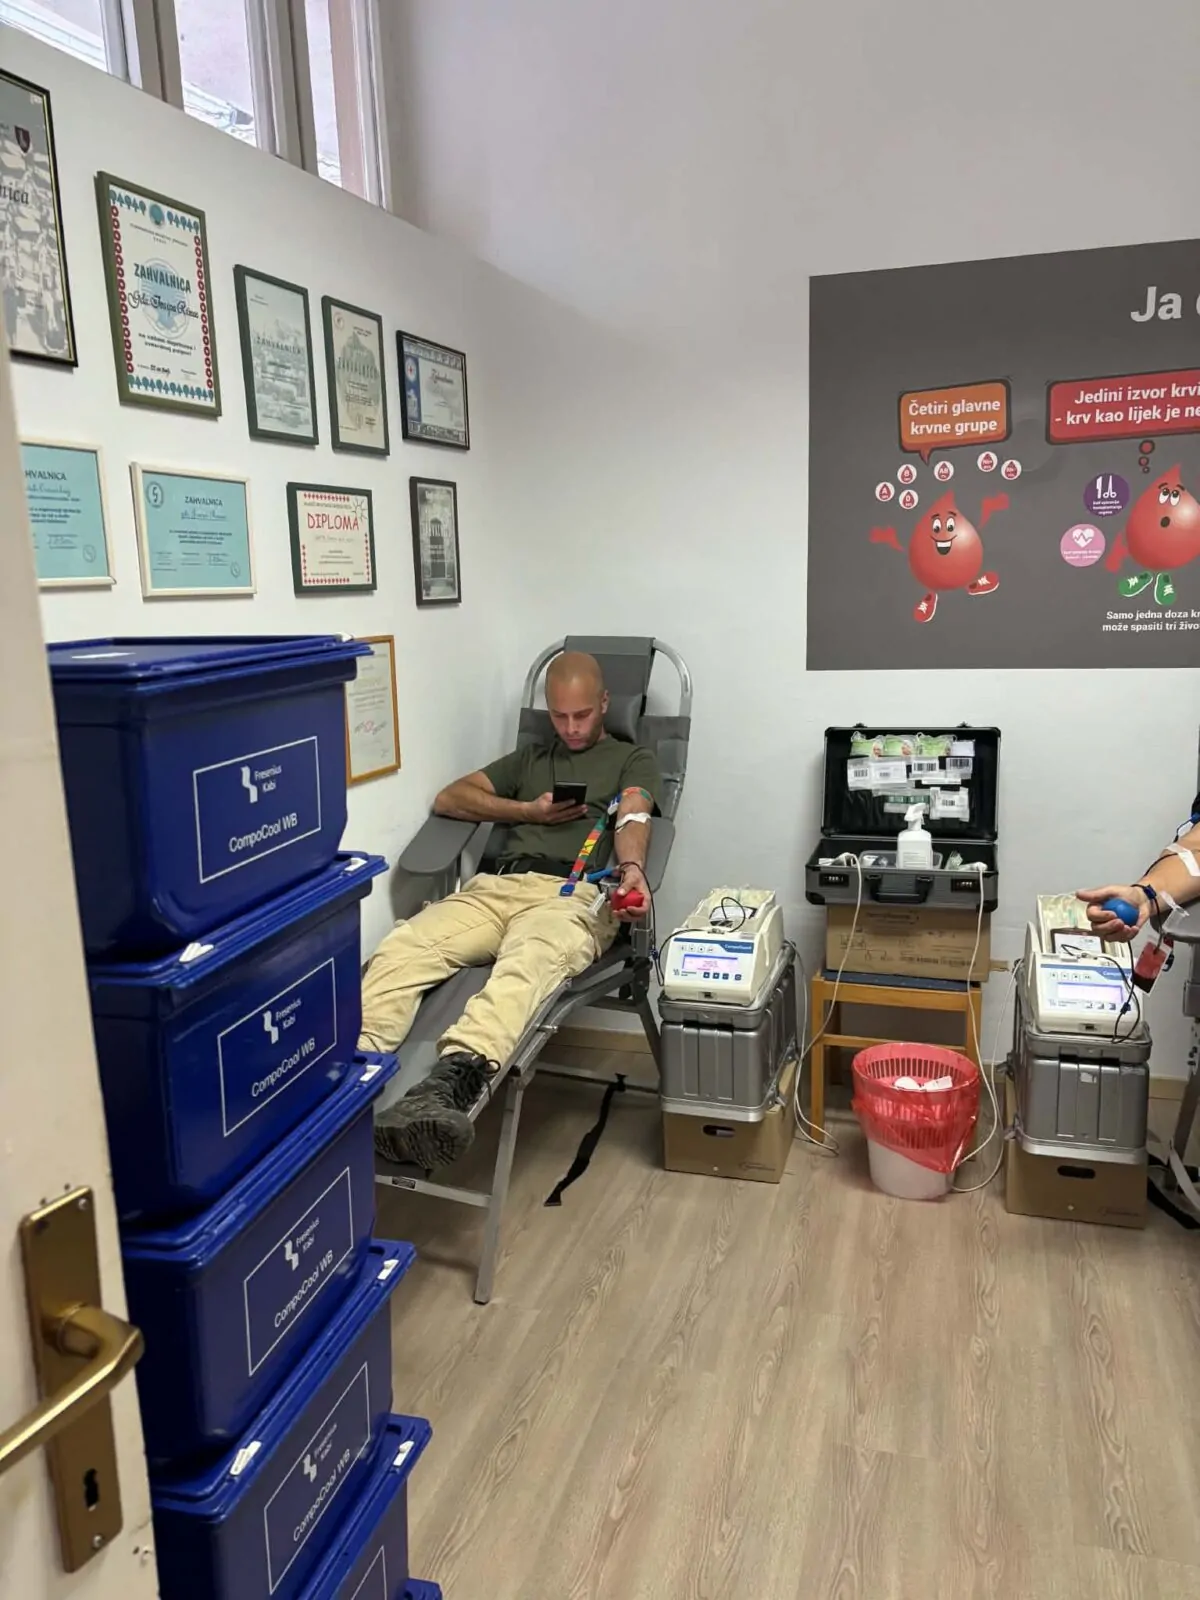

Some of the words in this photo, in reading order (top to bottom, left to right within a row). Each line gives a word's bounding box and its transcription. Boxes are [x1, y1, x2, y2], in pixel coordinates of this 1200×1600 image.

[133, 262, 192, 293] ZAHVALNICA
[1131, 286, 1182, 322] Ja
[1074, 387, 1123, 404] Jedini
[1127, 386, 1167, 401] izvor
[908, 399, 948, 416] Četiri
[952, 399, 1001, 417] glavne
[1066, 411, 1091, 425] krv
[1095, 409, 1124, 423] kao
[1128, 405, 1162, 424] lijek
[1164, 404, 1180, 422] je
[910, 421, 951, 436] krvne
[955, 420, 998, 436] grupe
[881, 486, 888, 494] A
[307, 511, 360, 531] DIPLOMA
[1106, 611, 1134, 620] Samo
[1135, 609, 1162, 621] jedna
[1164, 609, 1189, 619] doza
[1102, 622, 1129, 632] može
[1130, 621, 1163, 633] spasiti
[1165, 621, 1177, 631] tri
[228, 819, 282, 853] CompoCool
[282, 812, 298, 830] WB
[251, 1049, 300, 1098] CompoCool
[300, 1037, 316, 1057] WB
[274, 1266, 320, 1328] CompoCool
[319, 1249, 334, 1272] WB
[293, 1469, 337, 1542] CompoCool
